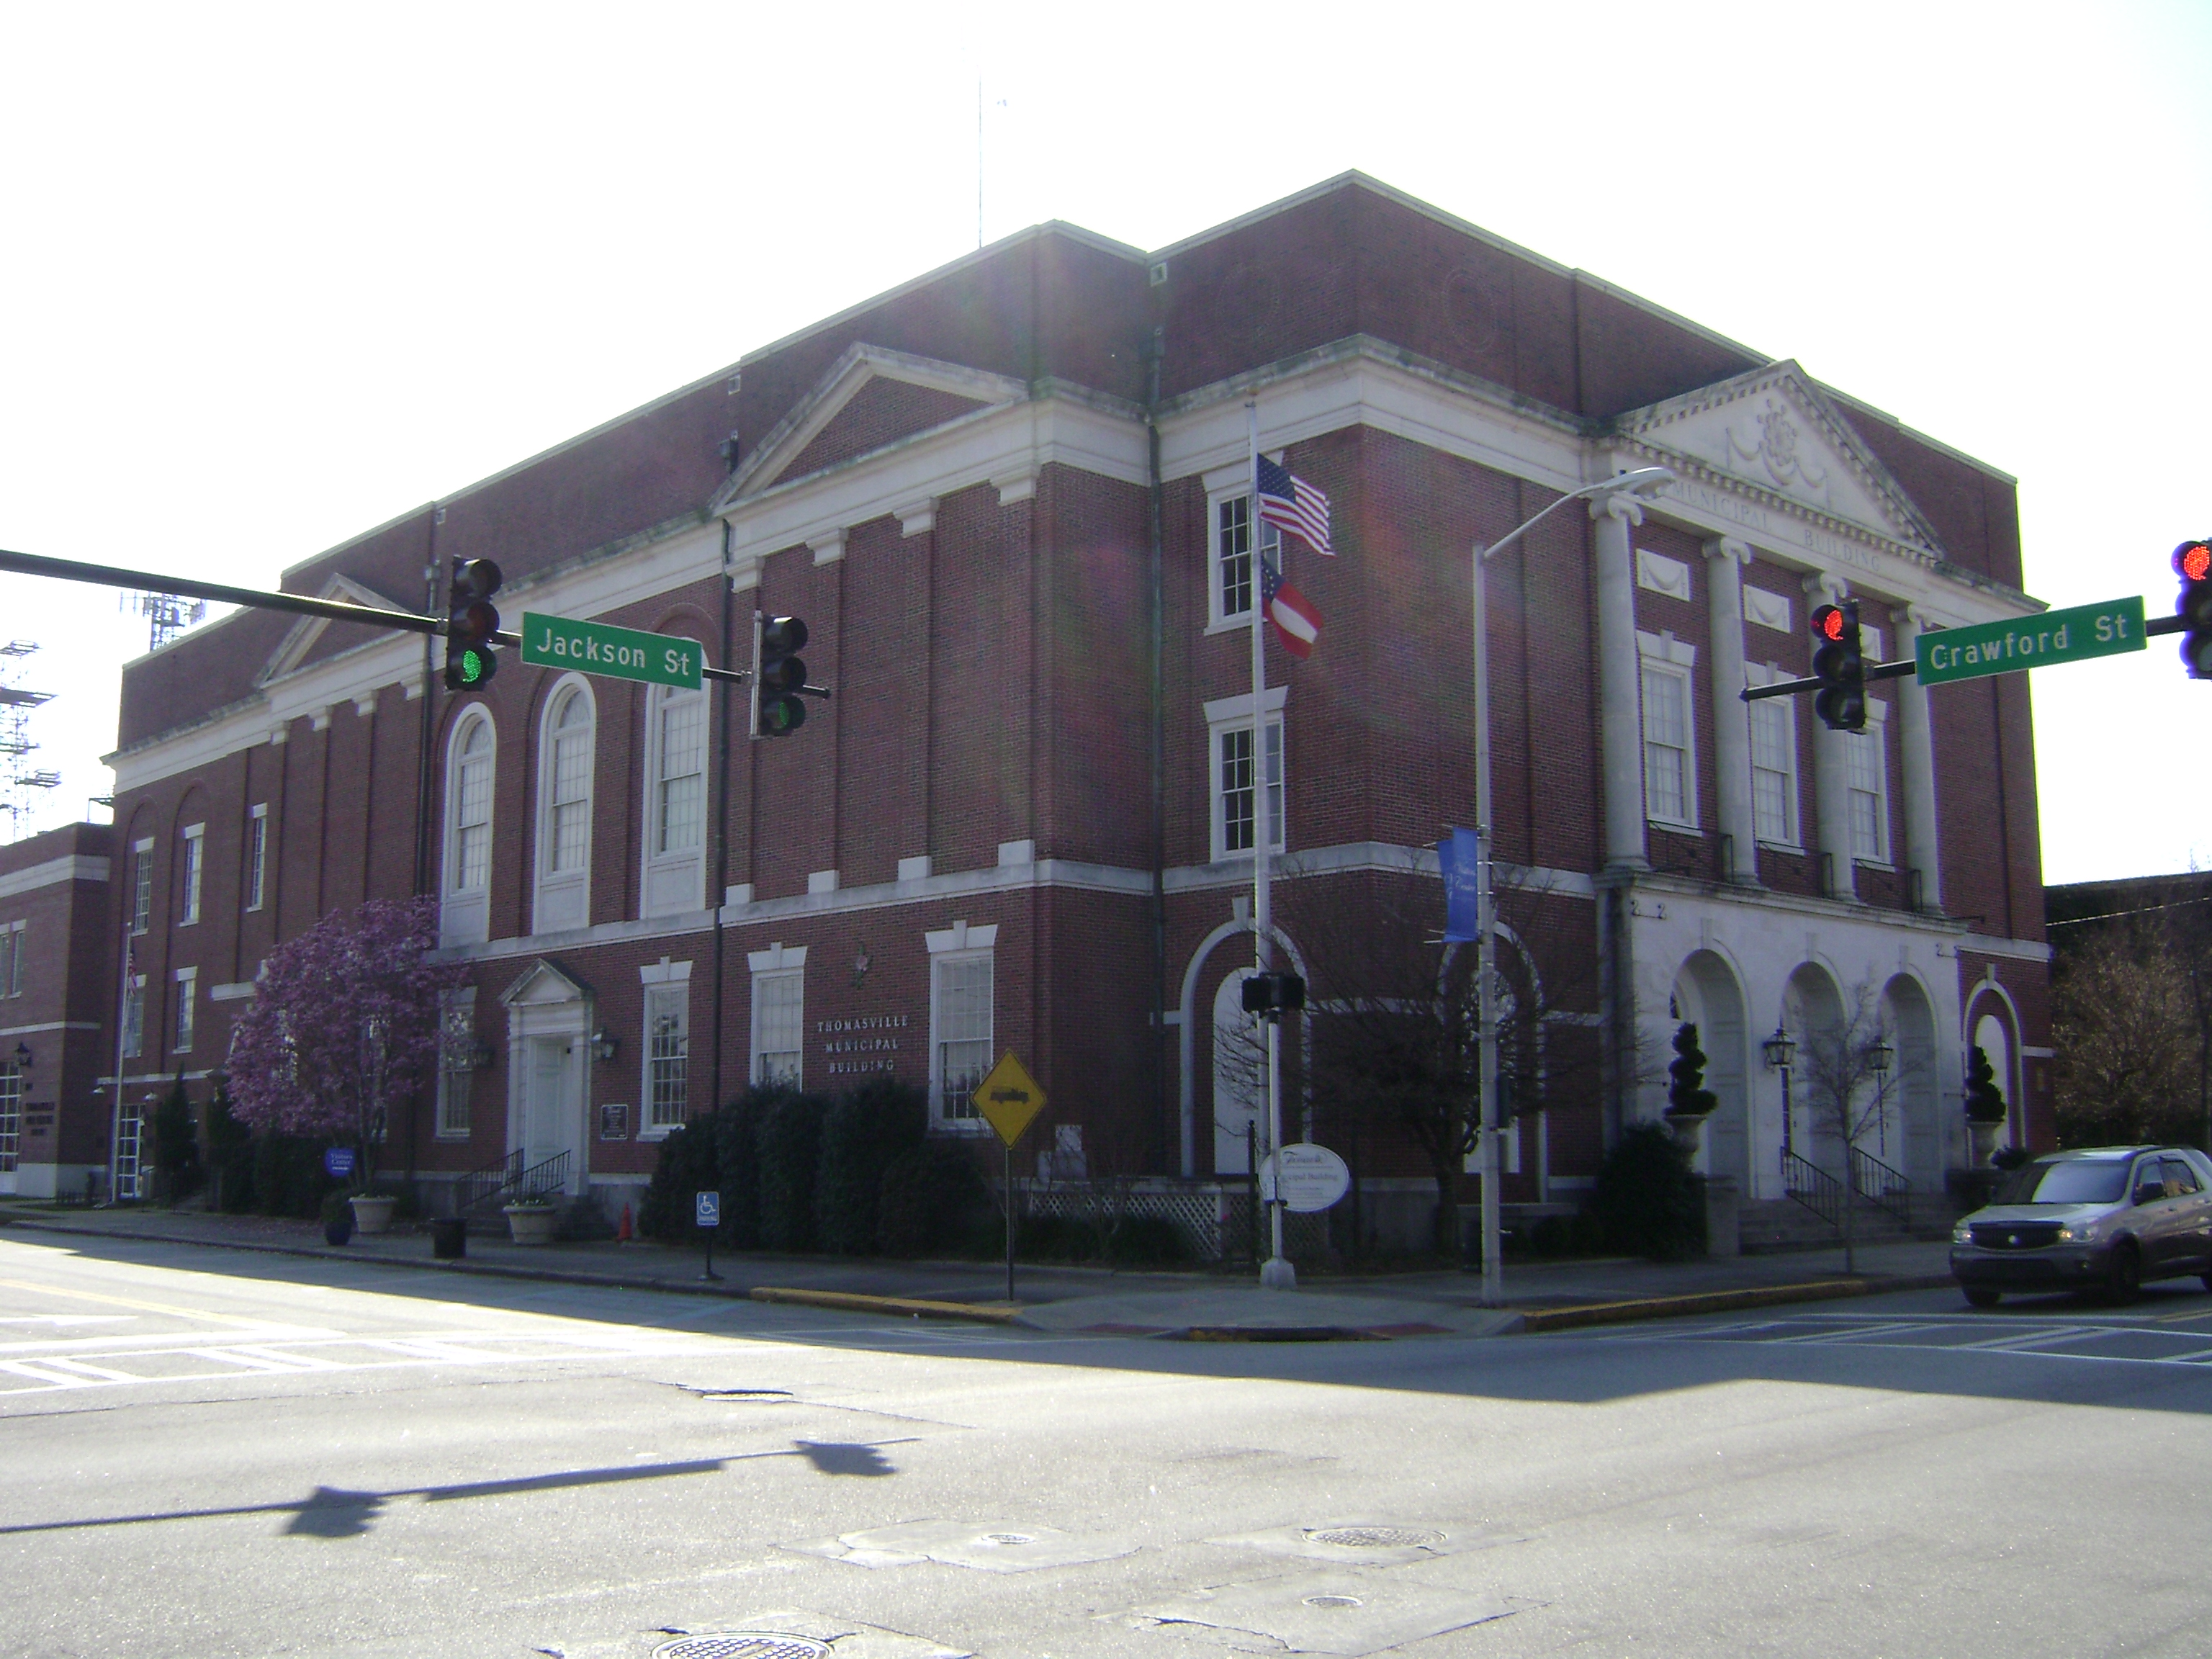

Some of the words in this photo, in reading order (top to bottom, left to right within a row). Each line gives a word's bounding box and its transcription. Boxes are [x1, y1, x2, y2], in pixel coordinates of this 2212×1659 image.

[1673, 482, 1771, 531] MUNICIPAL
[1804, 529, 1880, 571] BUILDING
[537, 628, 646, 668] Jackson
[664, 649, 690, 676] St
[1930, 624, 2068, 670] Crawford
[2094, 614, 2128, 642] St
[817, 1015, 908, 1032] THOMASVILLE
[826, 1038, 899, 1053] MUNICIPAL
[830, 1059, 894, 1074] BUILDING
